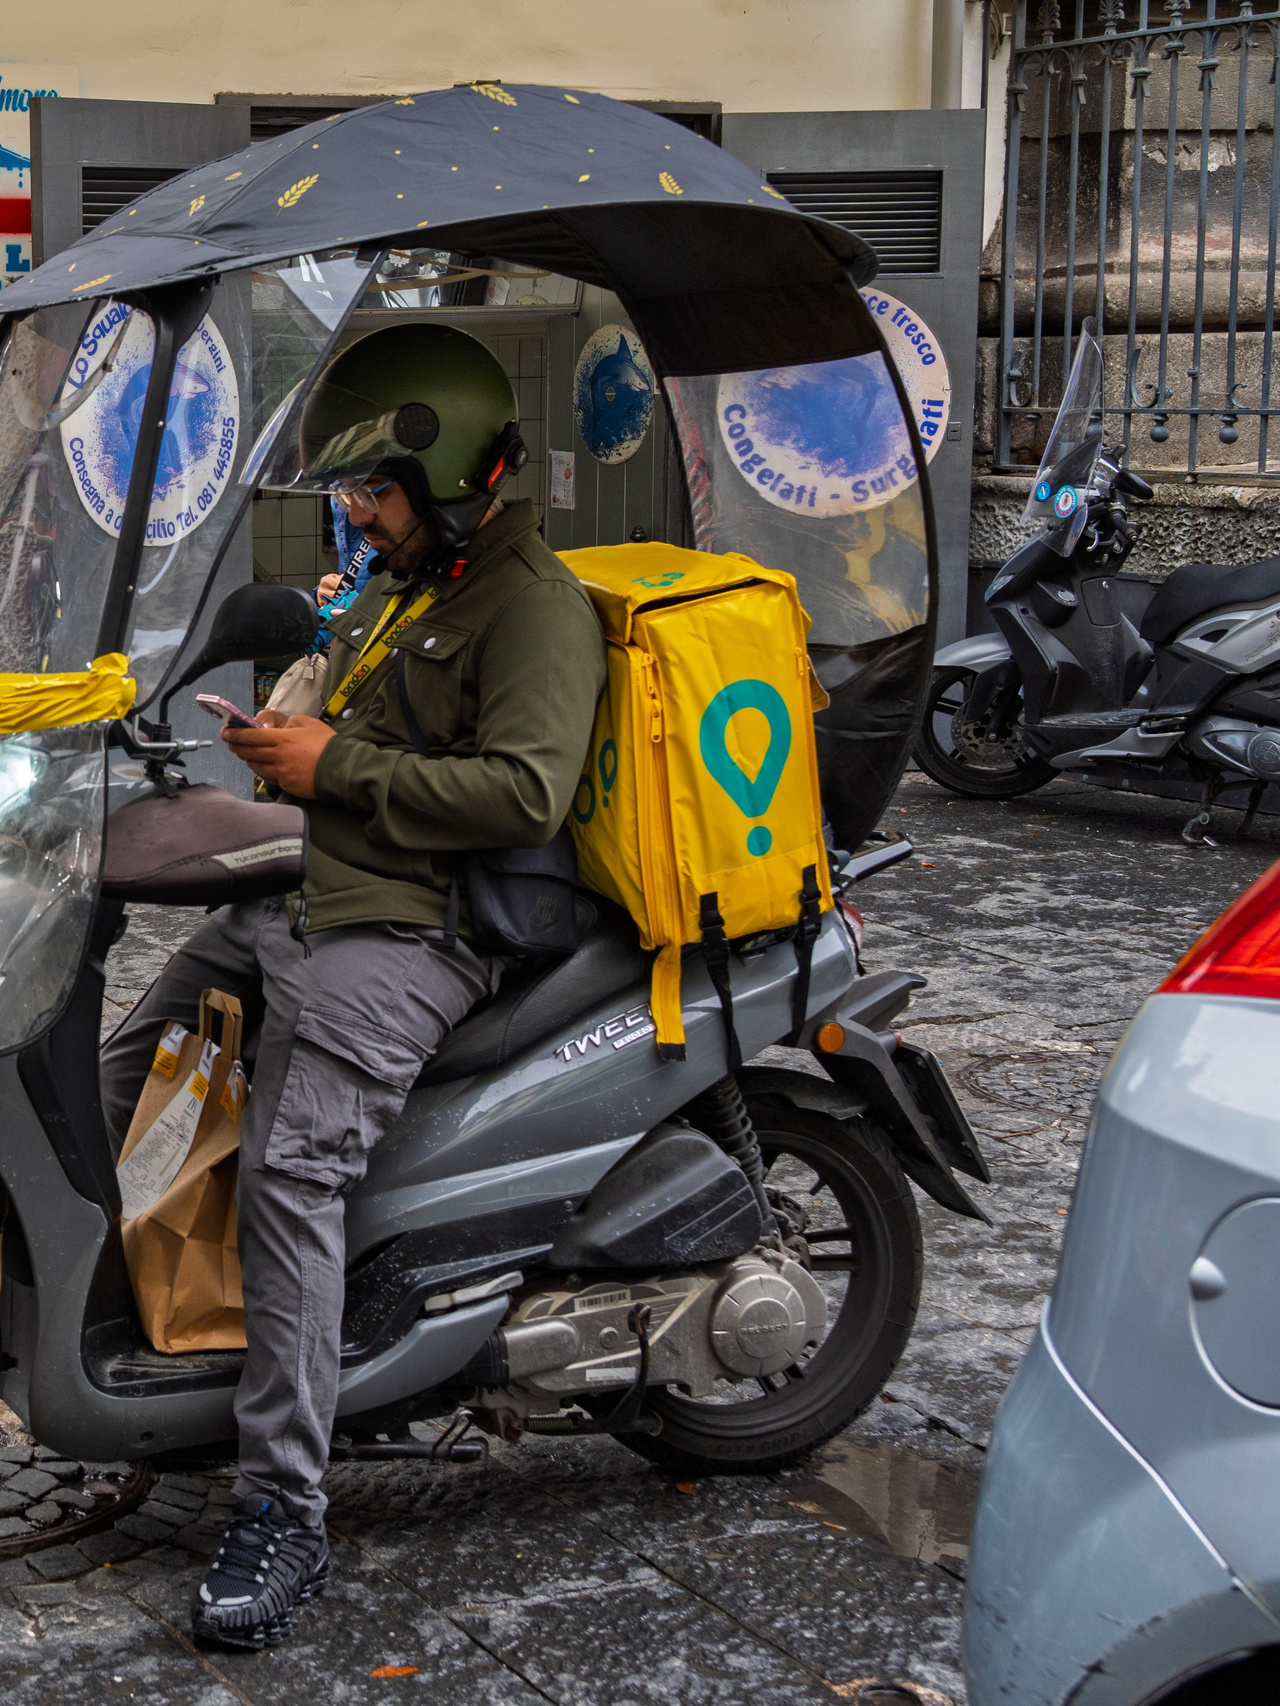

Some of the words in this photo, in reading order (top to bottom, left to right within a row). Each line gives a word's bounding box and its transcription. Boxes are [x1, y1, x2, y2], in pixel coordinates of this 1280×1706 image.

[891, 306, 937, 366] fresco
[67, 357, 89, 388] Lo
[69, 437, 106, 513] Consegna
[104, 507, 115, 525] a
[114, 510, 176, 540] dcilio
[176, 506, 198, 532] Tel.
[197, 486, 218, 512] 081
[214, 416, 236, 480] 445855
[723, 403, 818, 508] Congelati
[381, 614, 414, 649] london
[339, 662, 372, 698] london
[553, 1003, 652, 1061] TWEE
